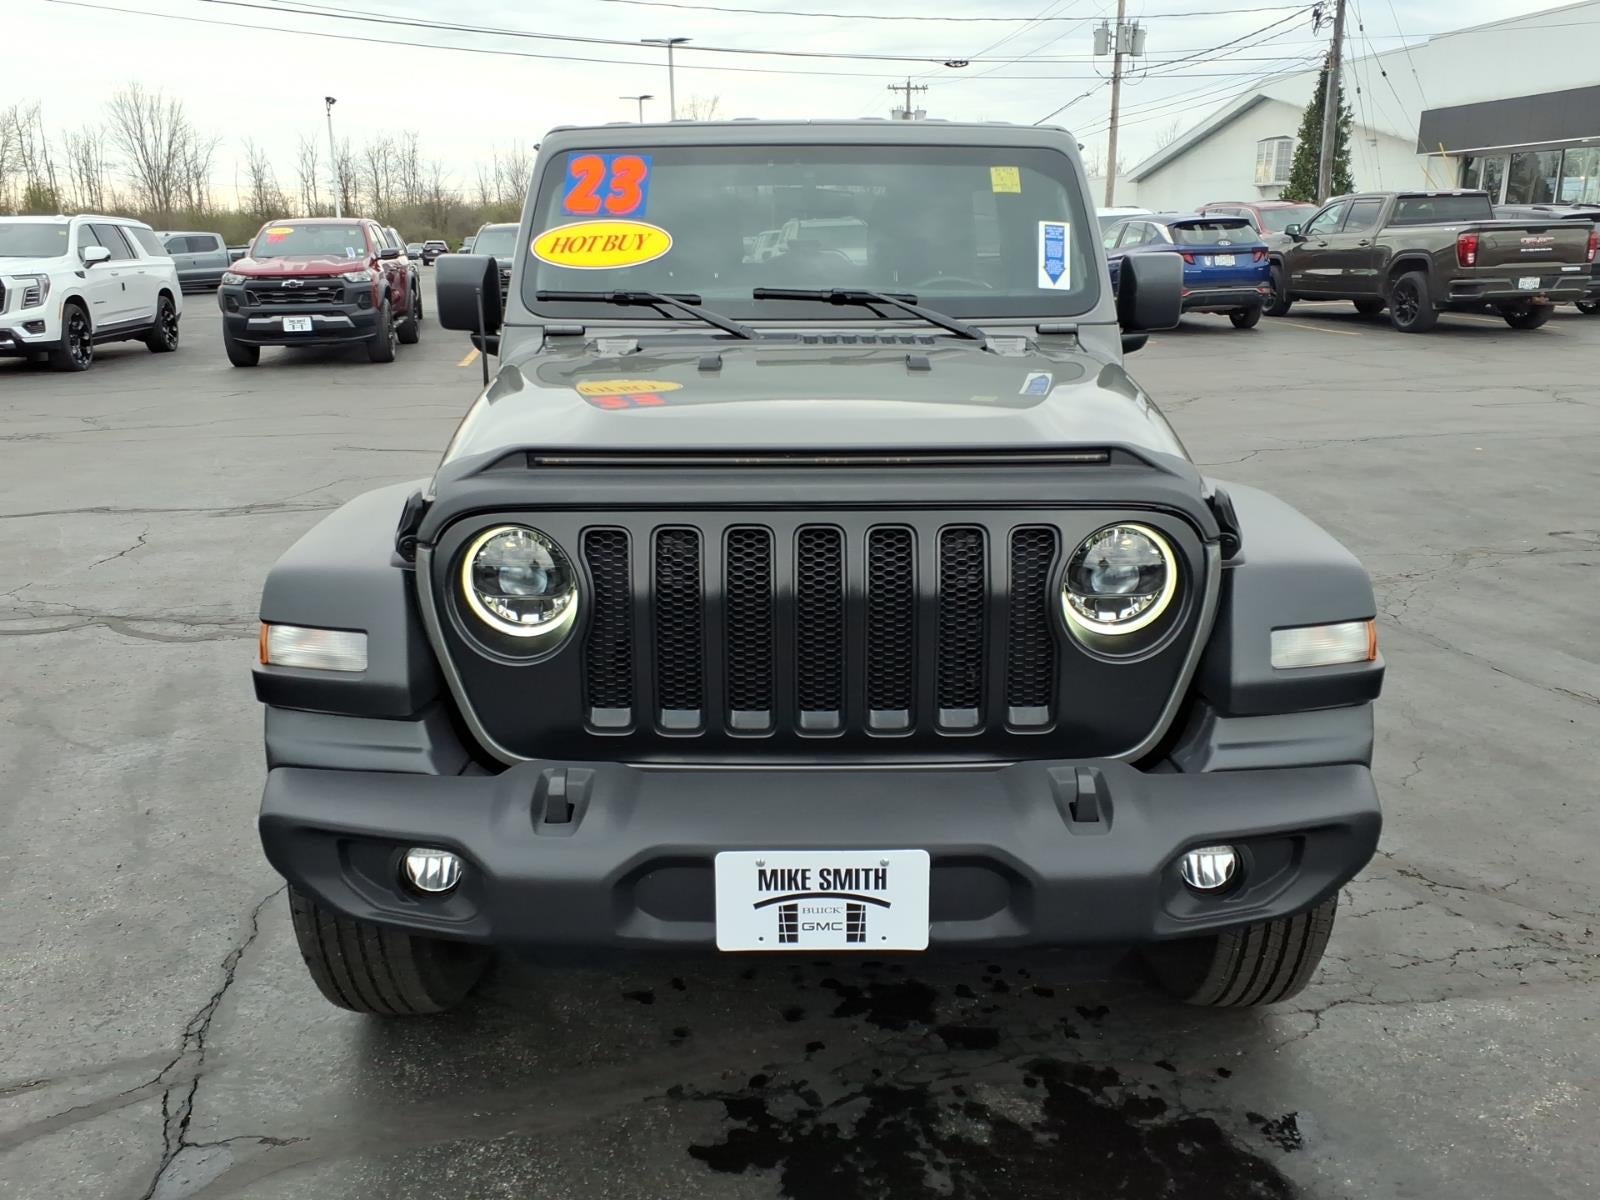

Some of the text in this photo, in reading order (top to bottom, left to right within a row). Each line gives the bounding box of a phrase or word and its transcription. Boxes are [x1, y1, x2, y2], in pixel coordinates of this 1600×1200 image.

[564, 154, 648, 215] 23
[549, 233, 652, 254] HOT BUY
[758, 868, 887, 891] MIKE SMITH
[801, 922, 844, 931] GMC
